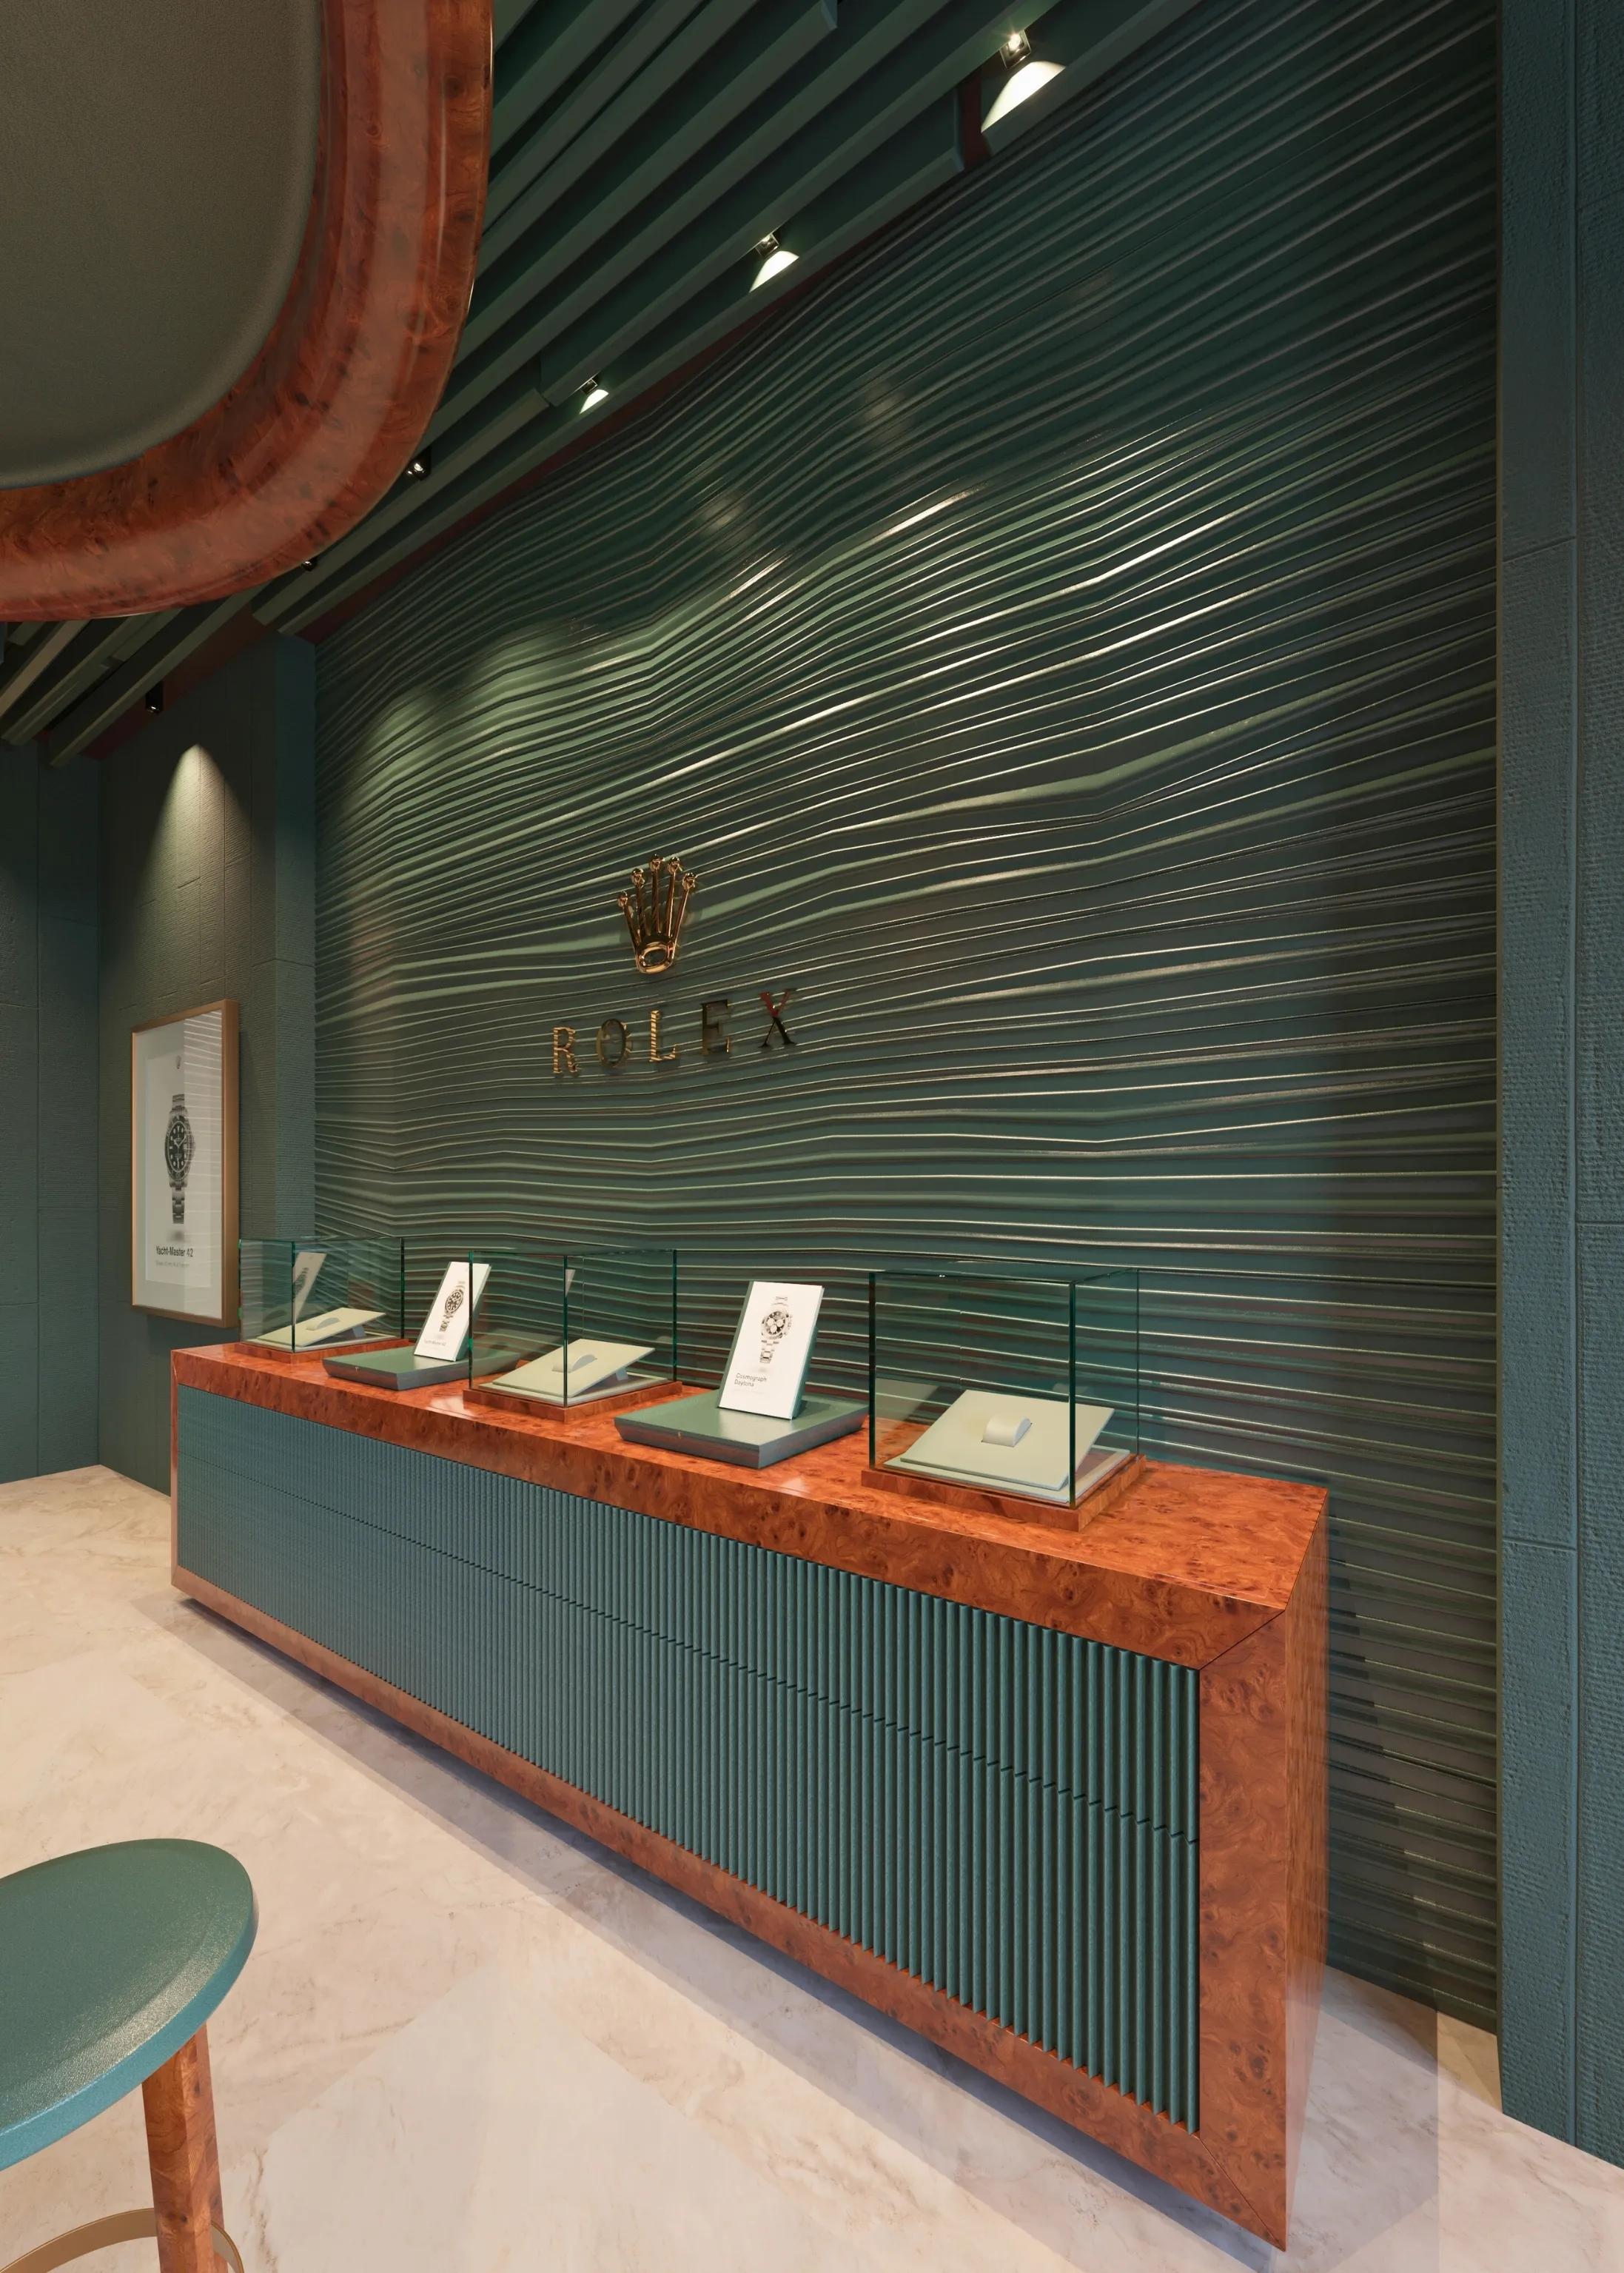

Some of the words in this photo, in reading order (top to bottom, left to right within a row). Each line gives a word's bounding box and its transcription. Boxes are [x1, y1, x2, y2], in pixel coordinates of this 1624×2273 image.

[552, 989, 796, 1074] ROLEX
[187, 1248, 193, 1257] 42
[736, 1373, 767, 1382] Cosmograph
[734, 1379, 754, 1387] Daytona
